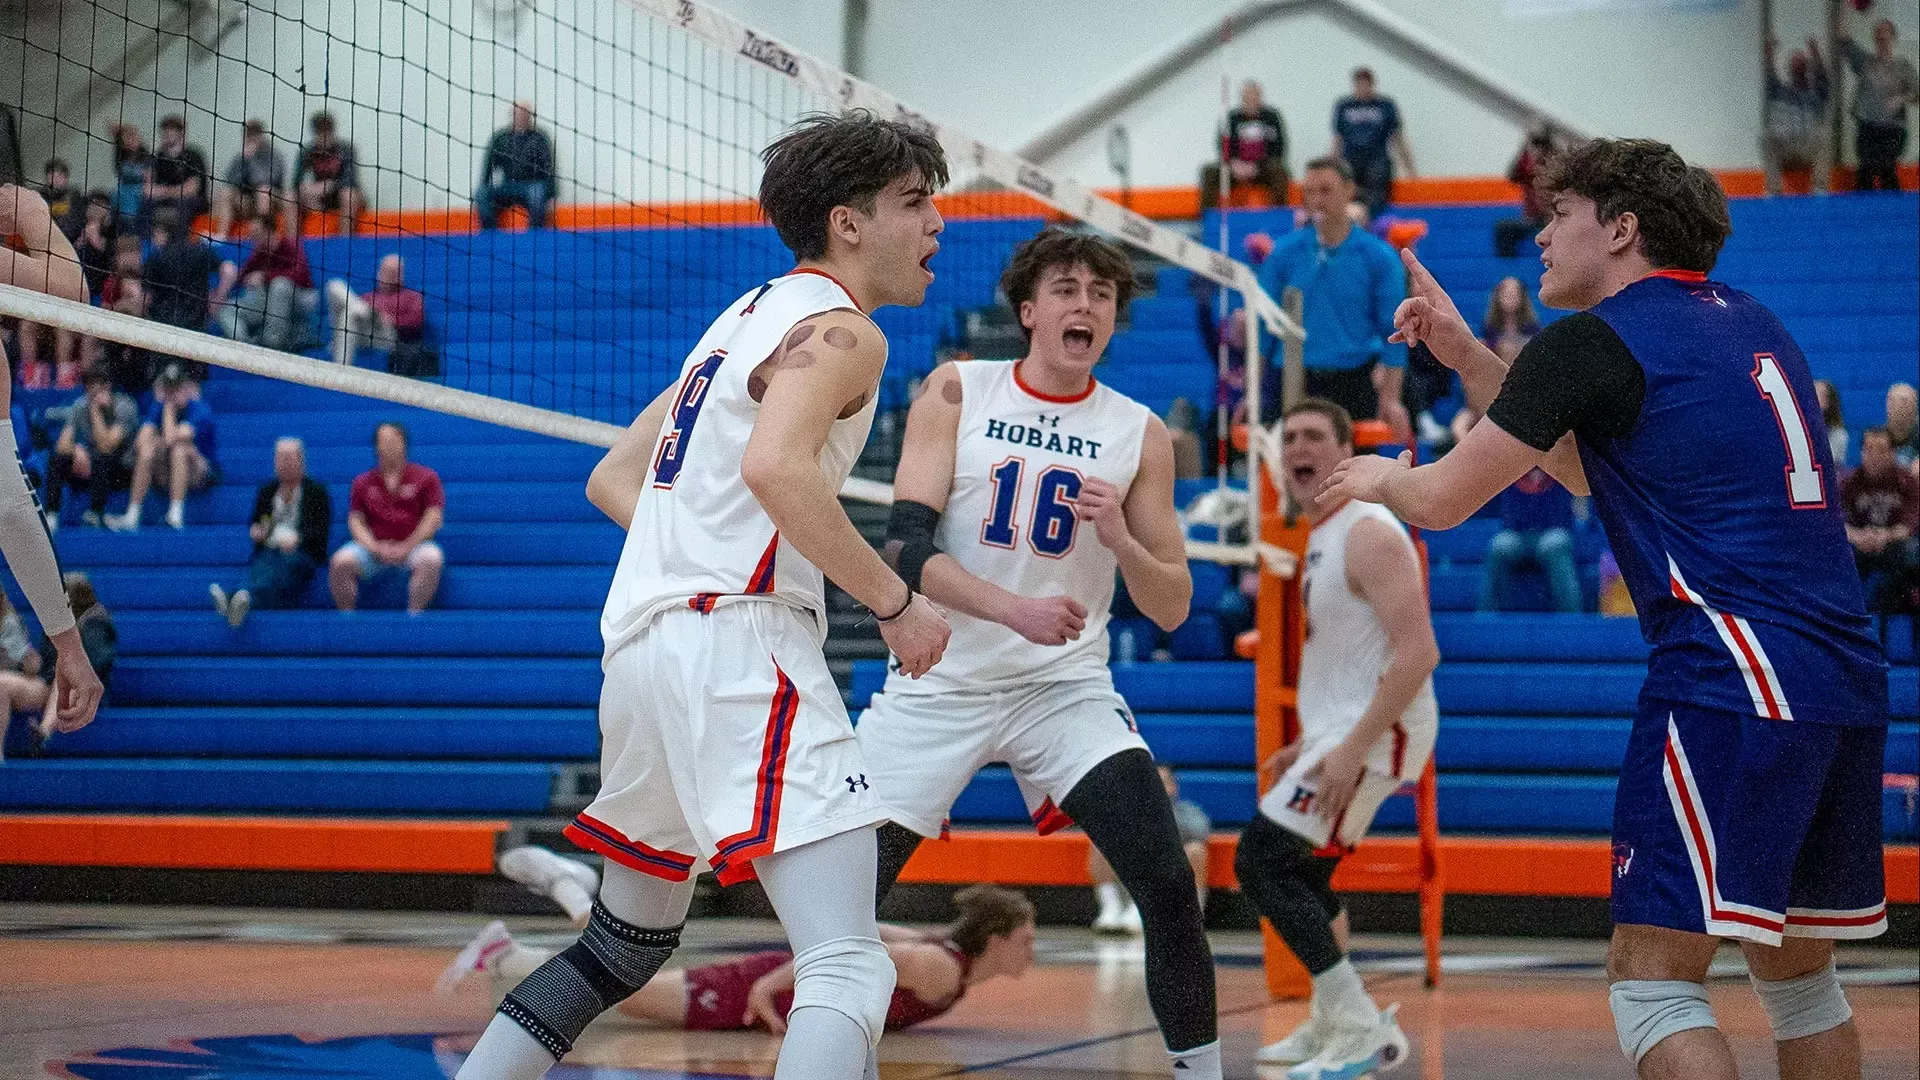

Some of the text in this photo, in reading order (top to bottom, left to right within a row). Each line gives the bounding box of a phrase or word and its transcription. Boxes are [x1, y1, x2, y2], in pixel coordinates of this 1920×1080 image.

[652, 348, 729, 490] 9
[985, 418, 1102, 460] HOBART
[1750, 352, 1828, 510] 1
[980, 455, 1086, 560] 16
